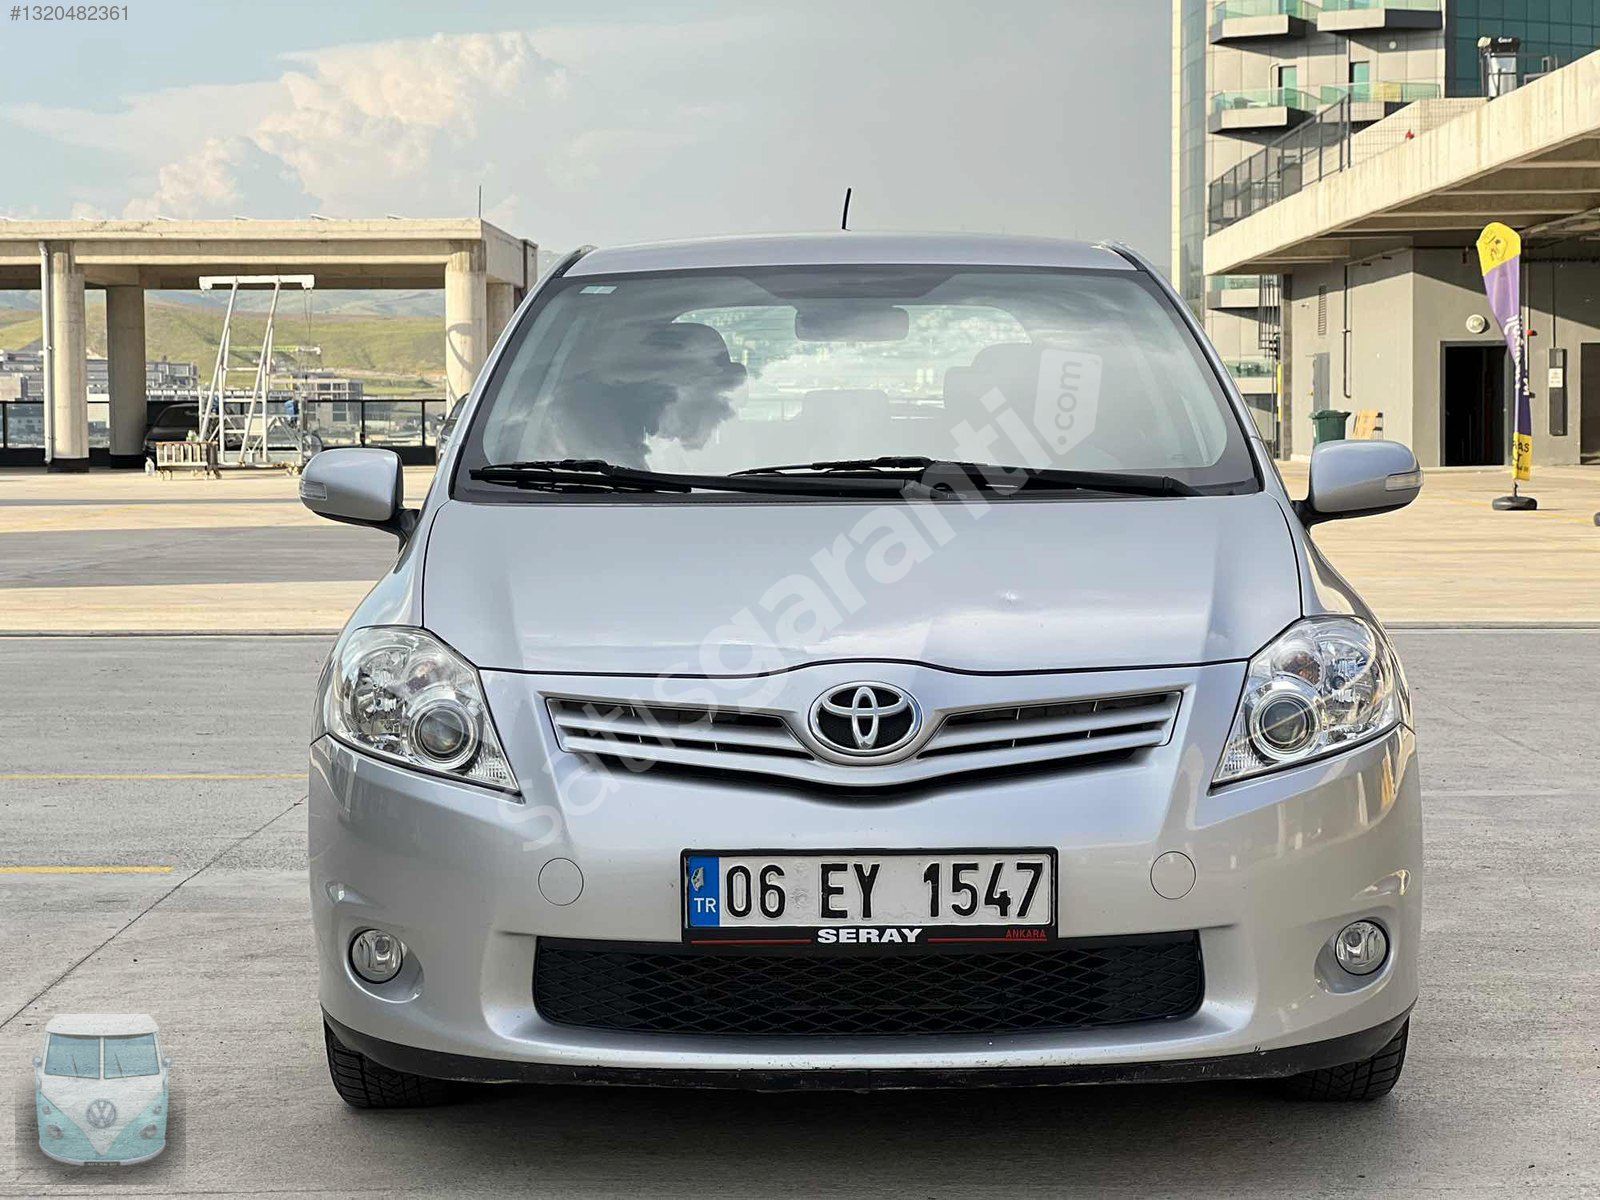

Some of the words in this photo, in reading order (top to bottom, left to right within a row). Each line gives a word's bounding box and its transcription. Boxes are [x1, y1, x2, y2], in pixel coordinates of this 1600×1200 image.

[726, 864, 786, 918] 06
[820, 863, 880, 919] EY
[923, 862, 1044, 918] 1547
[693, 897, 717, 913] TR
[817, 928, 923, 944] SERAY
[1005, 930, 1047, 939] ANKARA
